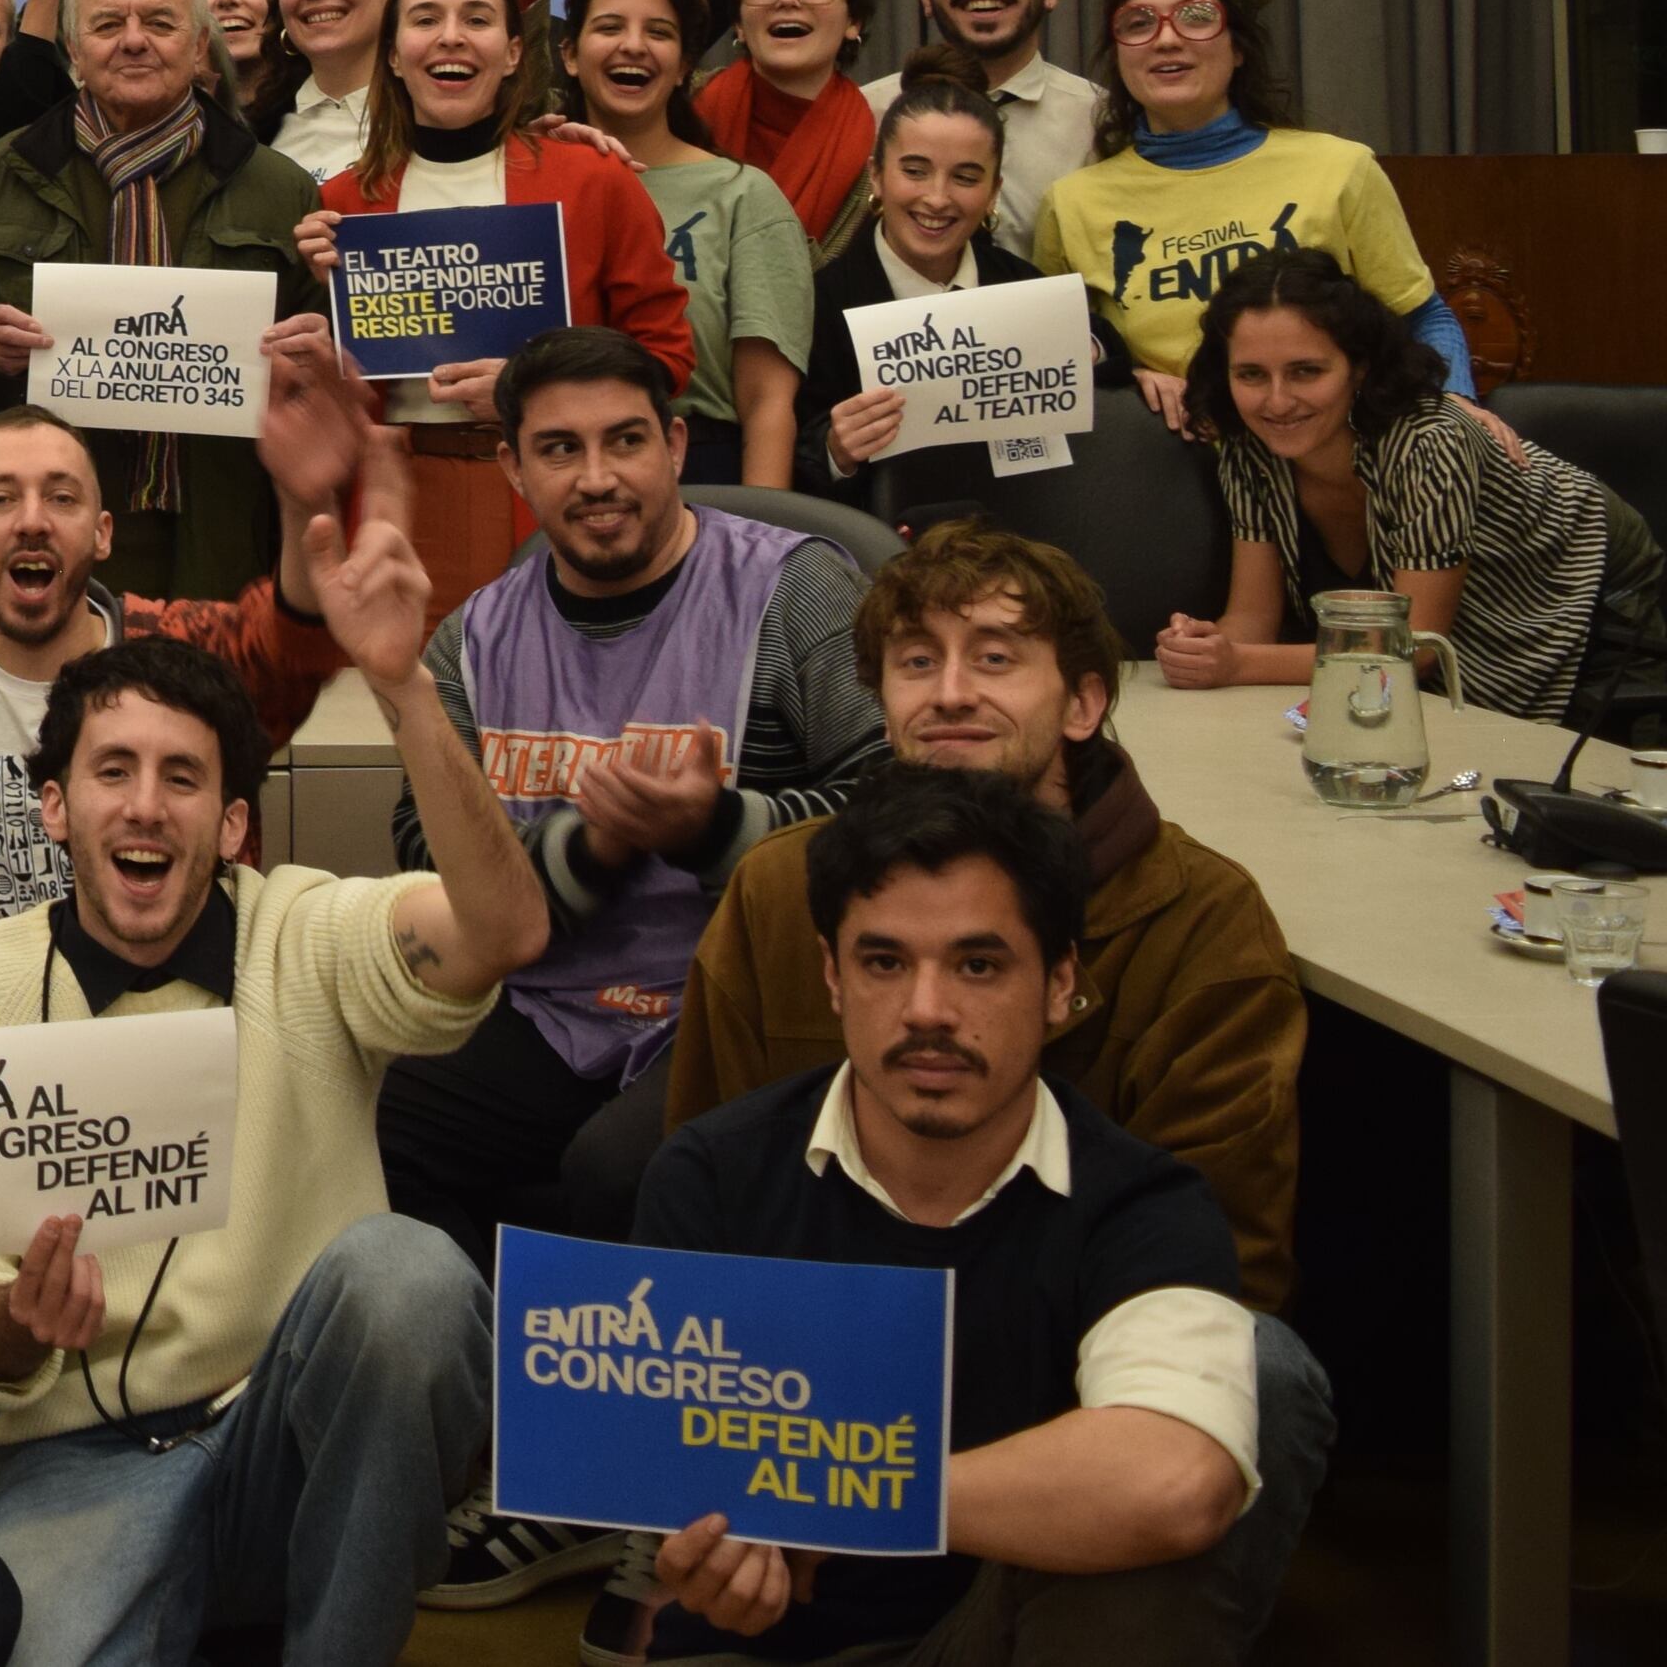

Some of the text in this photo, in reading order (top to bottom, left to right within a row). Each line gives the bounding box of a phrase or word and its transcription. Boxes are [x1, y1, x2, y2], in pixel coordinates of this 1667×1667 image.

[345, 243, 479, 272] EL TEATRO
[1162, 221, 1259, 259] FESTIVAL
[347, 261, 545, 294] INDEPENDIENTE
[114, 295, 187, 337] ENTRÁ
[349, 284, 543, 316] EXISTE PORQUE
[352, 313, 455, 338] RESISTE
[873, 313, 985, 360] ENTRÁ AL
[71, 337, 228, 365] AL CONGRESO
[878, 347, 1022, 386] CONGRESO
[57, 358, 240, 385] X LA ANULACIÓN
[963, 359, 1077, 400] DEFENDÉ
[51, 378, 244, 407] DEL DECRETO 345
[934, 390, 1076, 424] AL TEATRO
[27, 1084, 78, 1119] AL
[37, 1131, 209, 1191] DEFENDÉ
[85, 1172, 207, 1220] AL INT
[525, 1278, 741, 1359] ENTRÁ AL
[525, 1344, 811, 1410] CONGRESO
[683, 1407, 916, 1464] DEFENDÉ
[747, 1458, 915, 1510] AL INT
